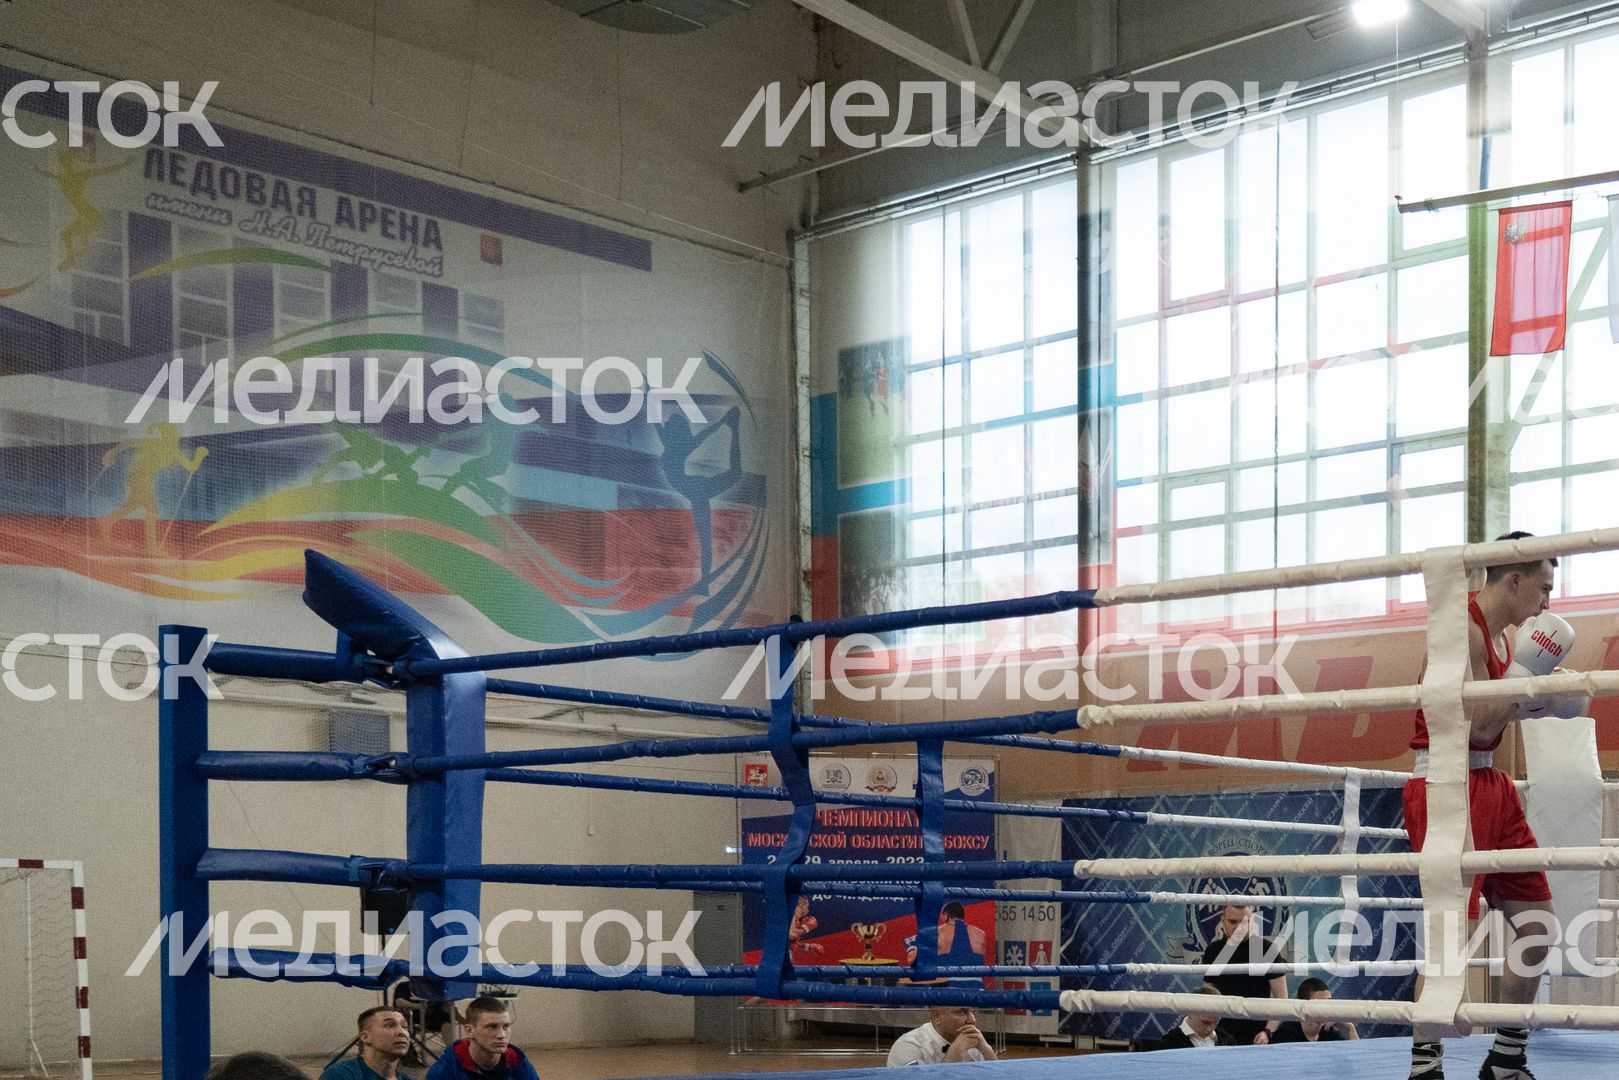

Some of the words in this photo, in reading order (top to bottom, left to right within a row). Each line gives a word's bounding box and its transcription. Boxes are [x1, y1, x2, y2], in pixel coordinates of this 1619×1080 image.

[143, 147, 317, 218] ЛЕДОВАЯ
[335, 195, 444, 251] АРЕНА
[1531, 630, 1563, 658] clinch
[852, 833, 918, 849] ОБЛАСТИ
